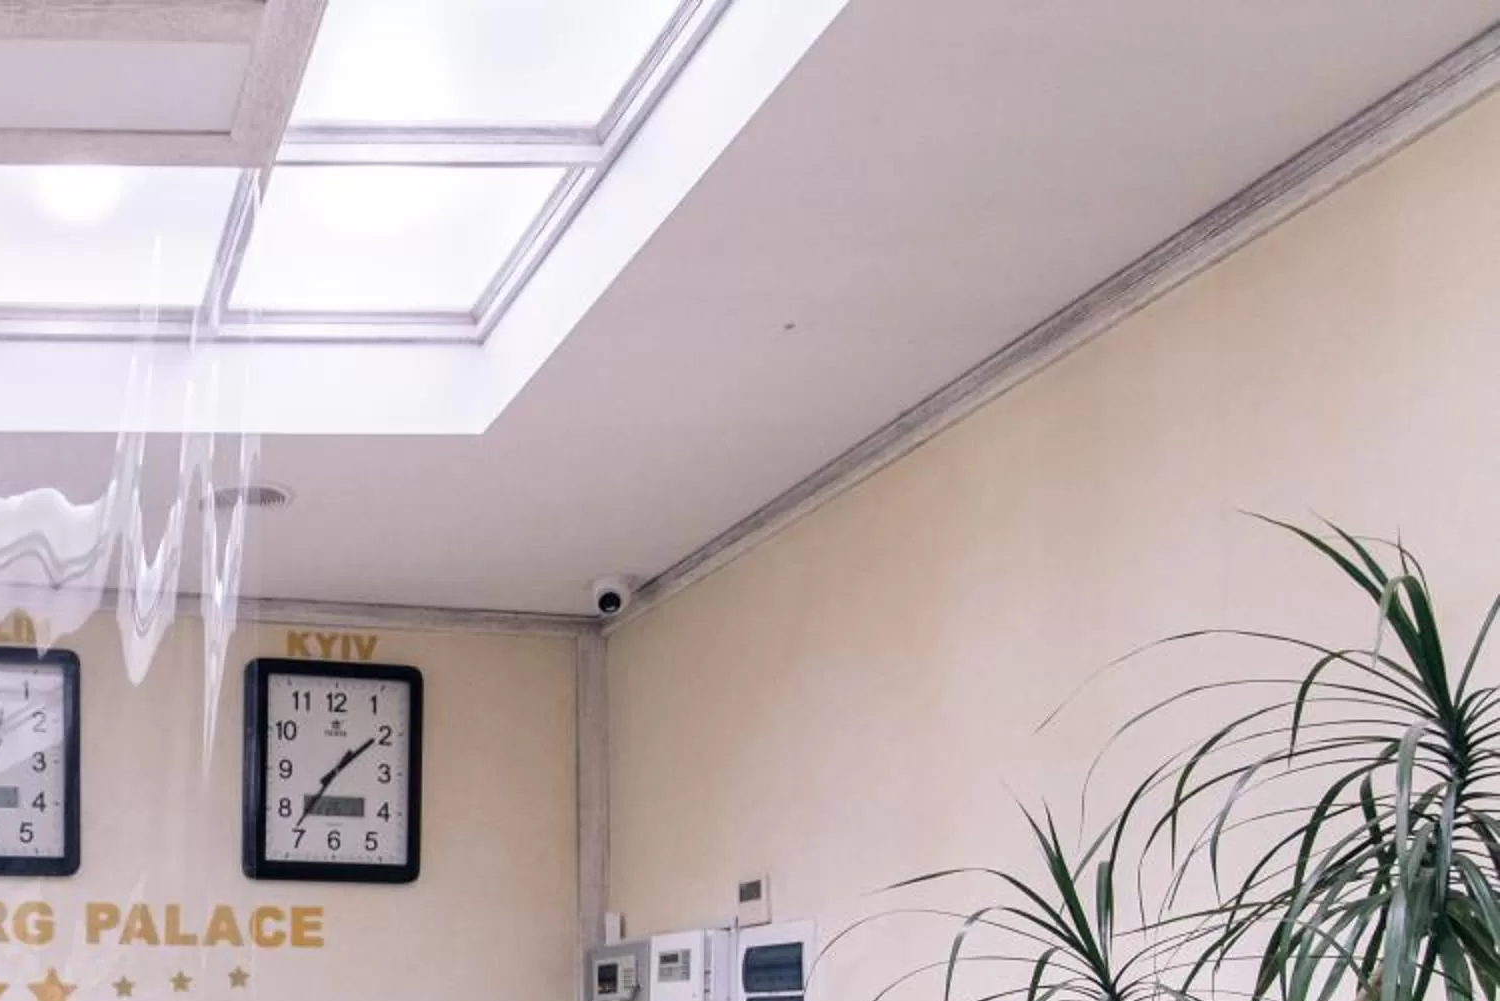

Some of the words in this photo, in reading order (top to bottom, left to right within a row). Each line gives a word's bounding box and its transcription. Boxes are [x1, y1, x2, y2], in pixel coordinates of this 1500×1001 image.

[286, 631, 377, 660] KYIV
[292, 691, 311, 711] 11
[326, 692, 348, 713] 12
[370, 694, 378, 715] 1
[32, 711, 47, 733] 2
[275, 720, 297, 741] 10
[378, 725, 393, 747] 2
[32, 752, 47, 773] 3
[278, 759, 292, 780] 9
[377, 763, 392, 785] 3
[31, 791, 47, 813] 4
[277, 797, 292, 818] 8
[376, 801, 391, 822] 4
[19, 822, 34, 844] 5
[291, 828, 307, 849] 7
[327, 830, 341, 851] 6
[364, 831, 379, 851] 5
[86, 901, 326, 949] PALACE
